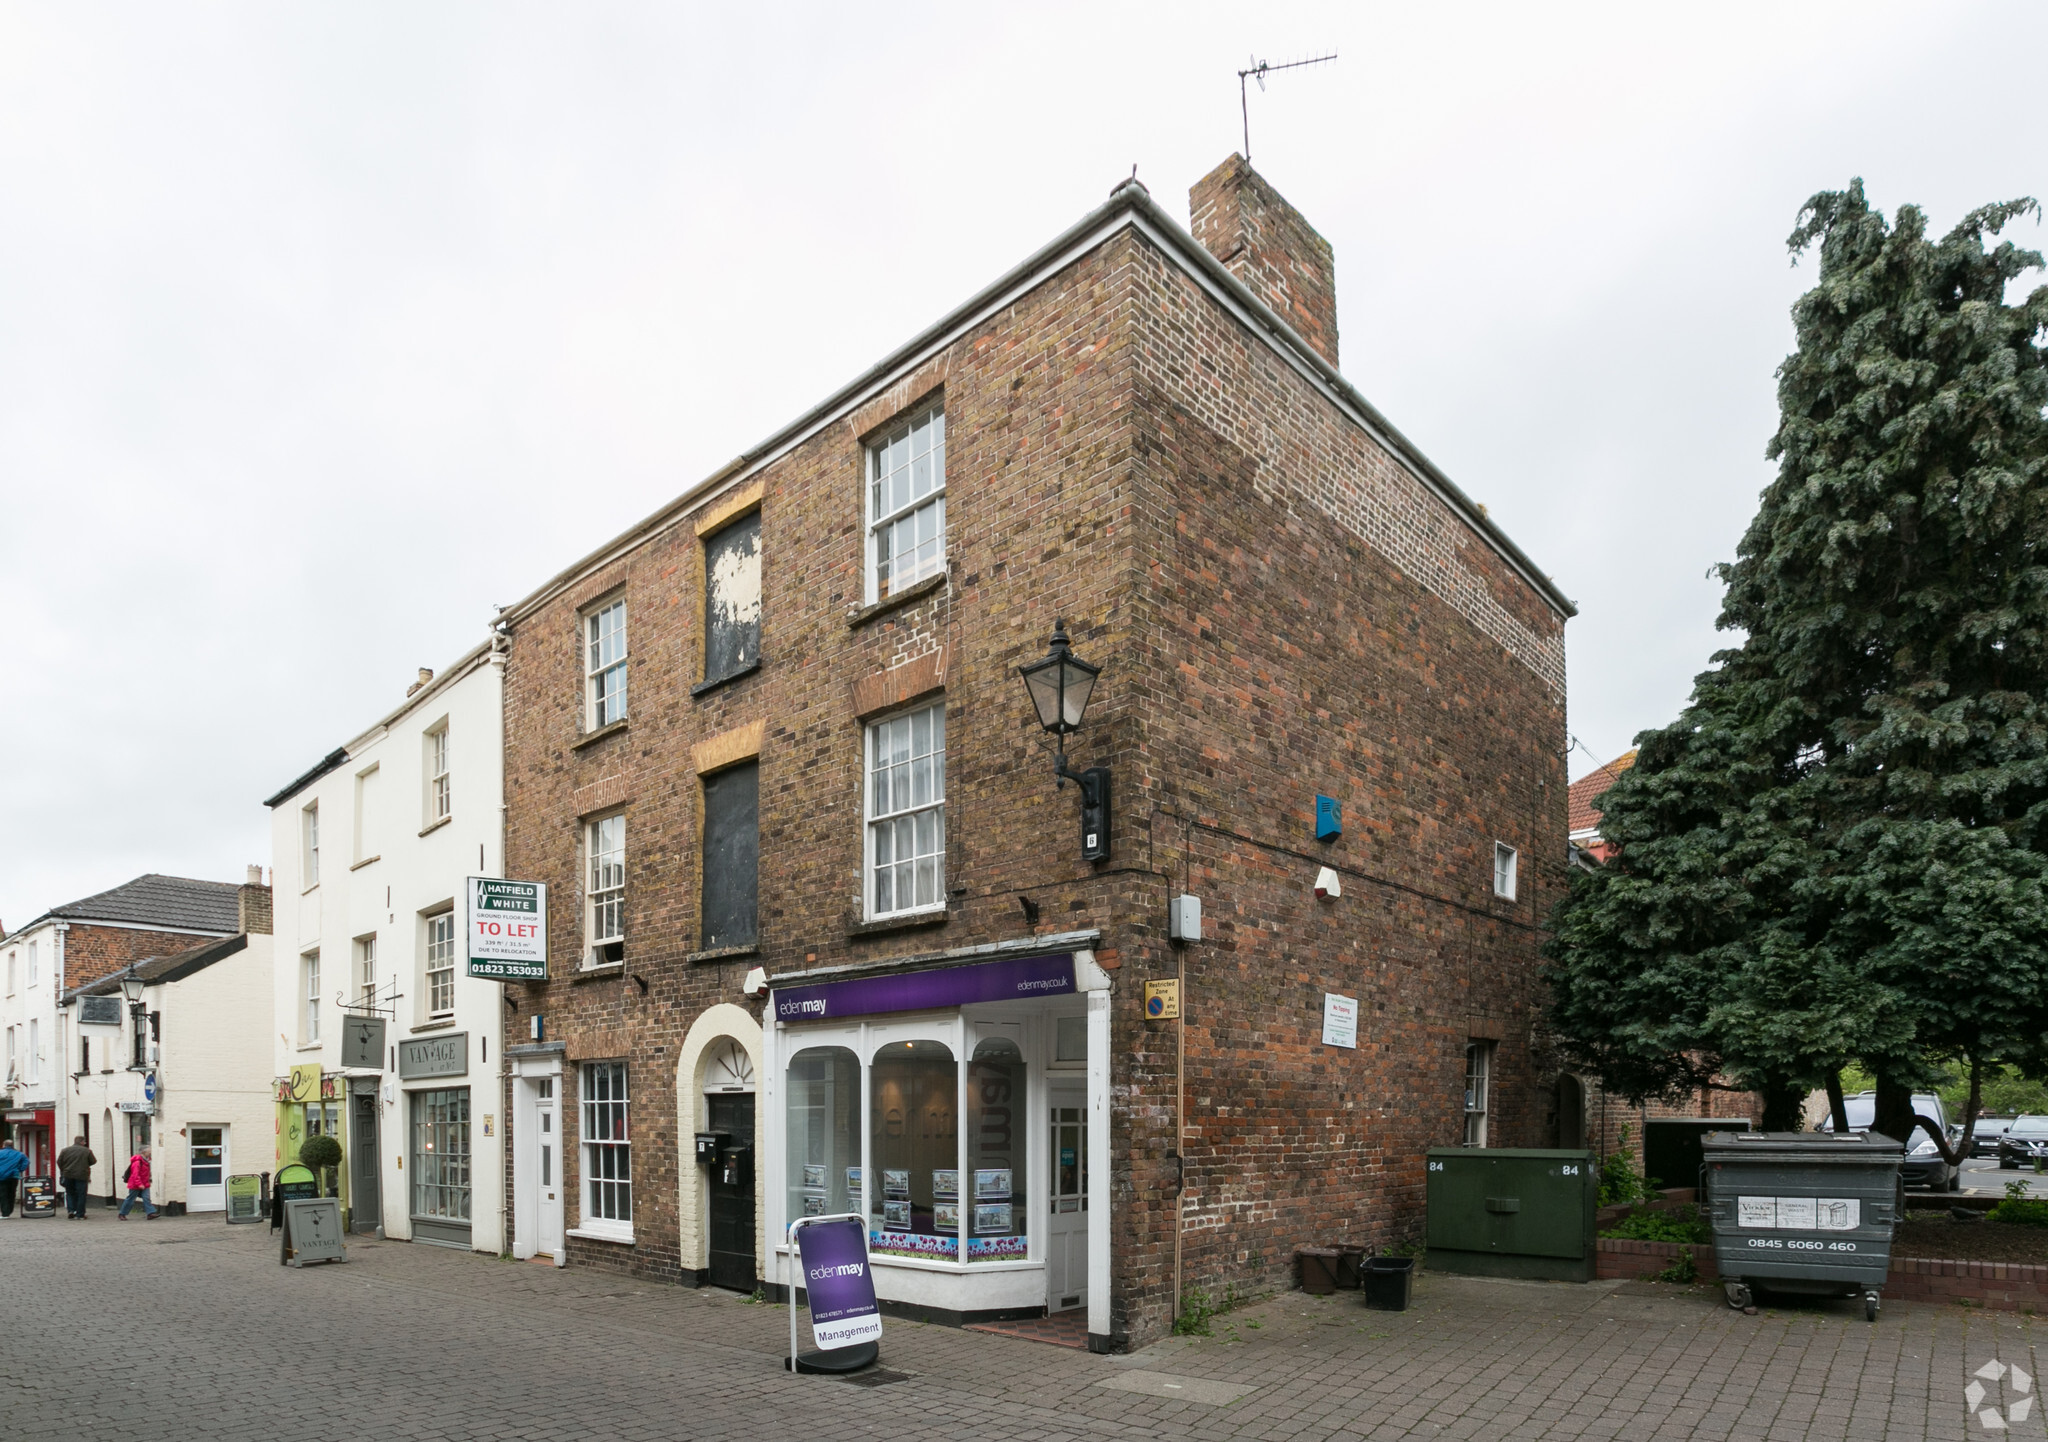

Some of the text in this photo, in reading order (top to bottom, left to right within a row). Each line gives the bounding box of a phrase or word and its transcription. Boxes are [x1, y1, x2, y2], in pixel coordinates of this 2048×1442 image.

[488, 884, 534, 896] HATFIELD
[492, 899, 530, 910] WHITE
[476, 922, 538, 938] TO LET
[501, 948, 537, 956] RELOCATION
[472, 964, 544, 976] 01823 353033
[1017, 976, 1068, 992] edenmay.co.uk
[780, 997, 826, 1015] edenmay
[410, 1042, 456, 1064] VANTAGE
[1429, 1162, 1444, 1172] 84
[1562, 1165, 1579, 1176] 84
[302, 1239, 336, 1248] VANTAGE
[1748, 1238, 1856, 1252] 0845 6060 460
[810, 1262, 864, 1280] edenmay
[818, 1322, 879, 1342] Management
